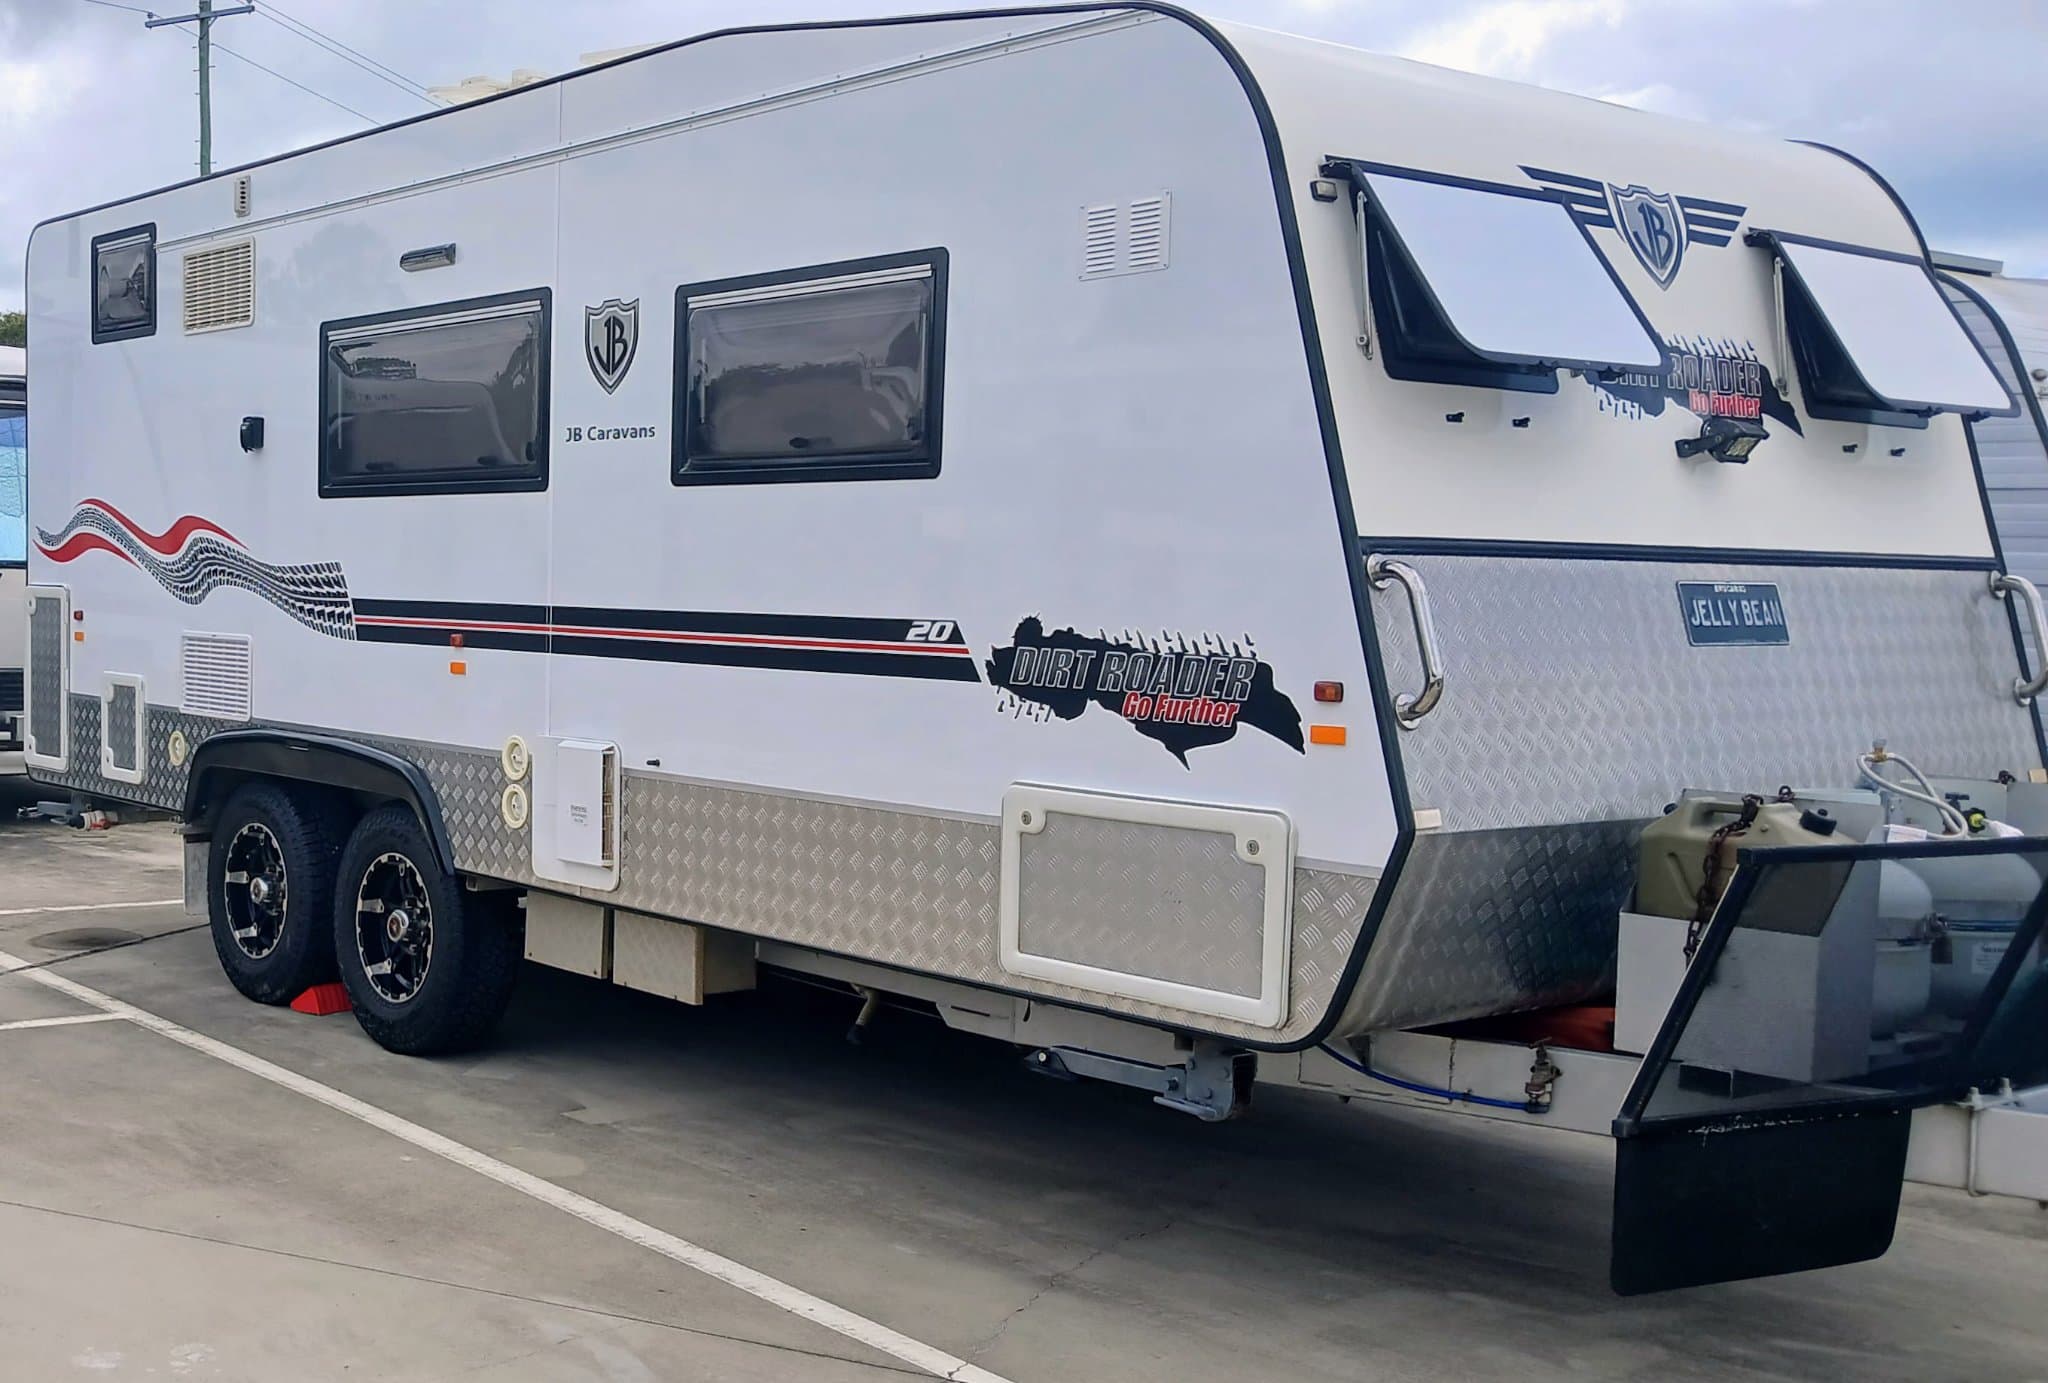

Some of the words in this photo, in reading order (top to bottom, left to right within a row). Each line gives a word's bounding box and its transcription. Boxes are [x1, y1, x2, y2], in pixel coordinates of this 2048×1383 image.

[1667, 352, 1763, 397] ROADER
[1709, 390, 1761, 419] Further
[565, 426, 583, 443] JB
[587, 425, 656, 441] Caravans
[1691, 598, 1741, 627] JELLY
[1741, 599, 1784, 627] BEAN
[904, 620, 955, 642] 20
[1009, 646, 1097, 690] DIRT
[1096, 650, 1257, 701] ROADER
[1121, 691, 1151, 721] Go
[1152, 693, 1240, 728] Further
